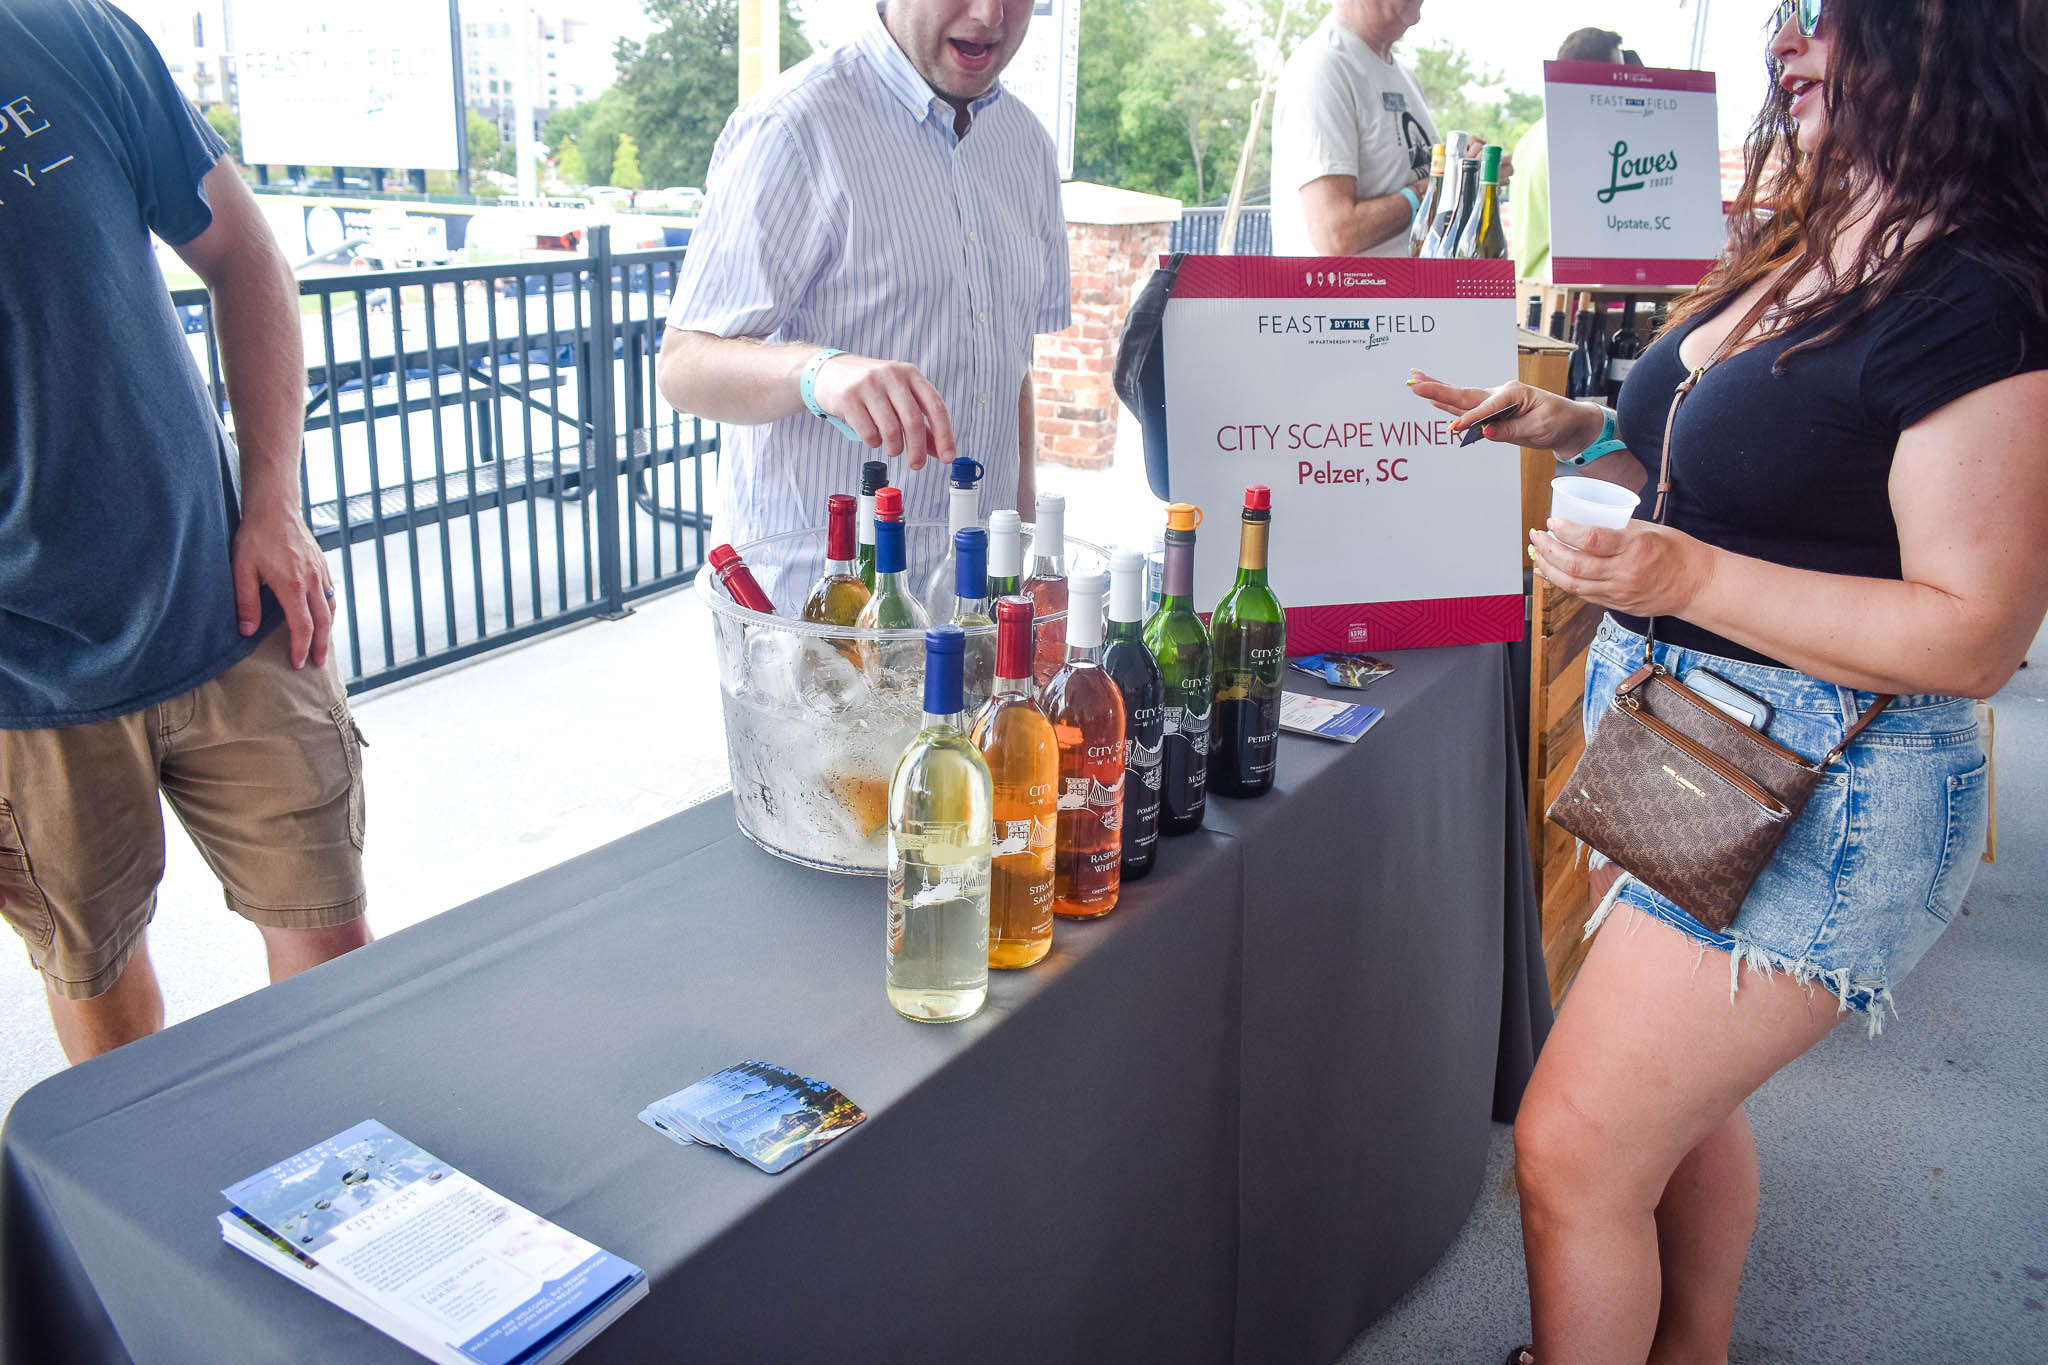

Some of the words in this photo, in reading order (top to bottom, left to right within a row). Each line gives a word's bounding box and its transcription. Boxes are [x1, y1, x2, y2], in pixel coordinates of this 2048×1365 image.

[1590, 94, 1624, 107] FEAST
[1647, 98, 1677, 111] FIELD
[1597, 140, 1678, 203] Lowes
[1607, 215, 1652, 232] Upstate,
[1655, 216, 1671, 230] SC
[1258, 315, 1327, 334] FEAST
[1334, 320, 1346, 329] BY
[1349, 320, 1365, 329] THE
[1375, 315, 1435, 333] FIELD
[1216, 423, 1280, 451] CITY
[1287, 422, 1373, 450] SCAPE
[1379, 420, 1479, 447] WINER
[1298, 459, 1370, 487] Pelzer,
[1376, 457, 1409, 483] SC
[1251, 648, 1273, 659] CITY
[1181, 677, 1204, 688] CITY
[1135, 706, 1157, 720] CITY
[1087, 744, 1114, 758] CITY
